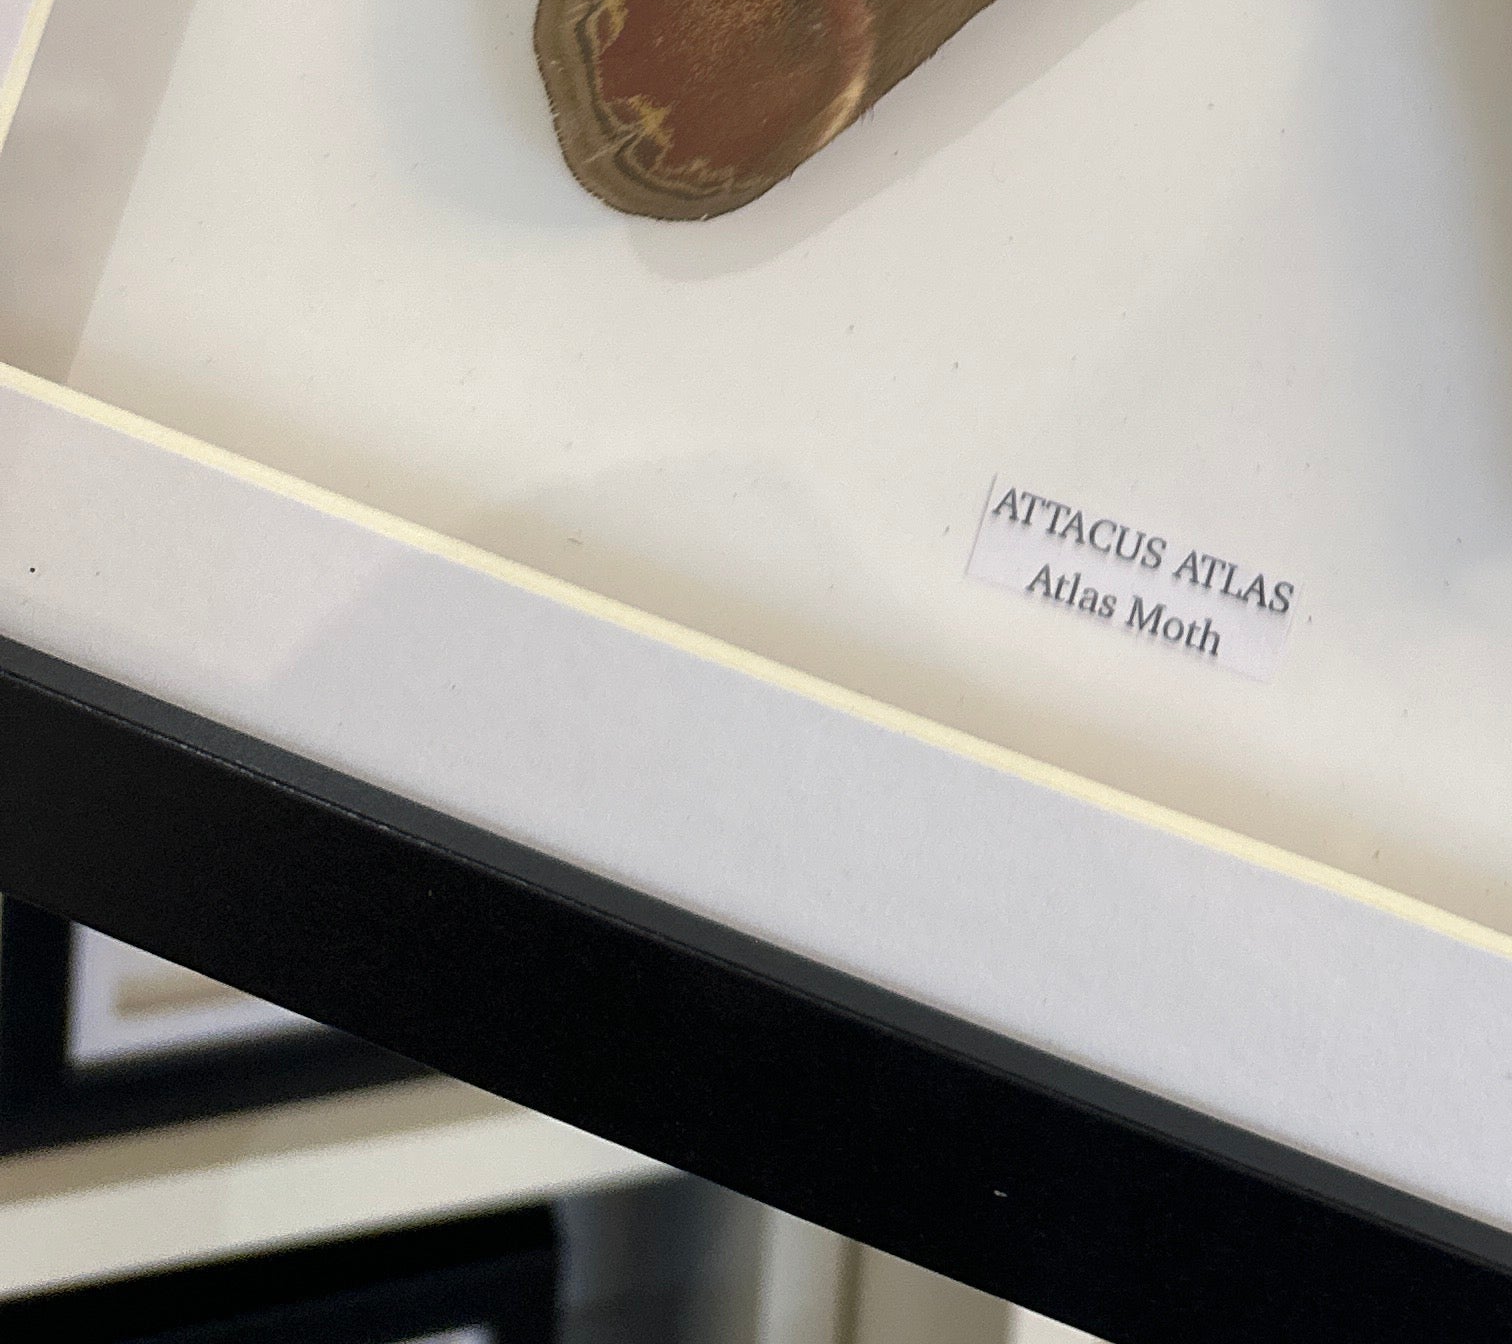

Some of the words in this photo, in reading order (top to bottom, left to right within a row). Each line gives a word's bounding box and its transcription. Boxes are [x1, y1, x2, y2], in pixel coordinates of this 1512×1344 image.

[992, 487, 1167, 569] ATTACUS
[1172, 550, 1294, 613] ATLAS
[1025, 564, 1117, 618] Atlas
[1125, 595, 1221, 656] Moth
